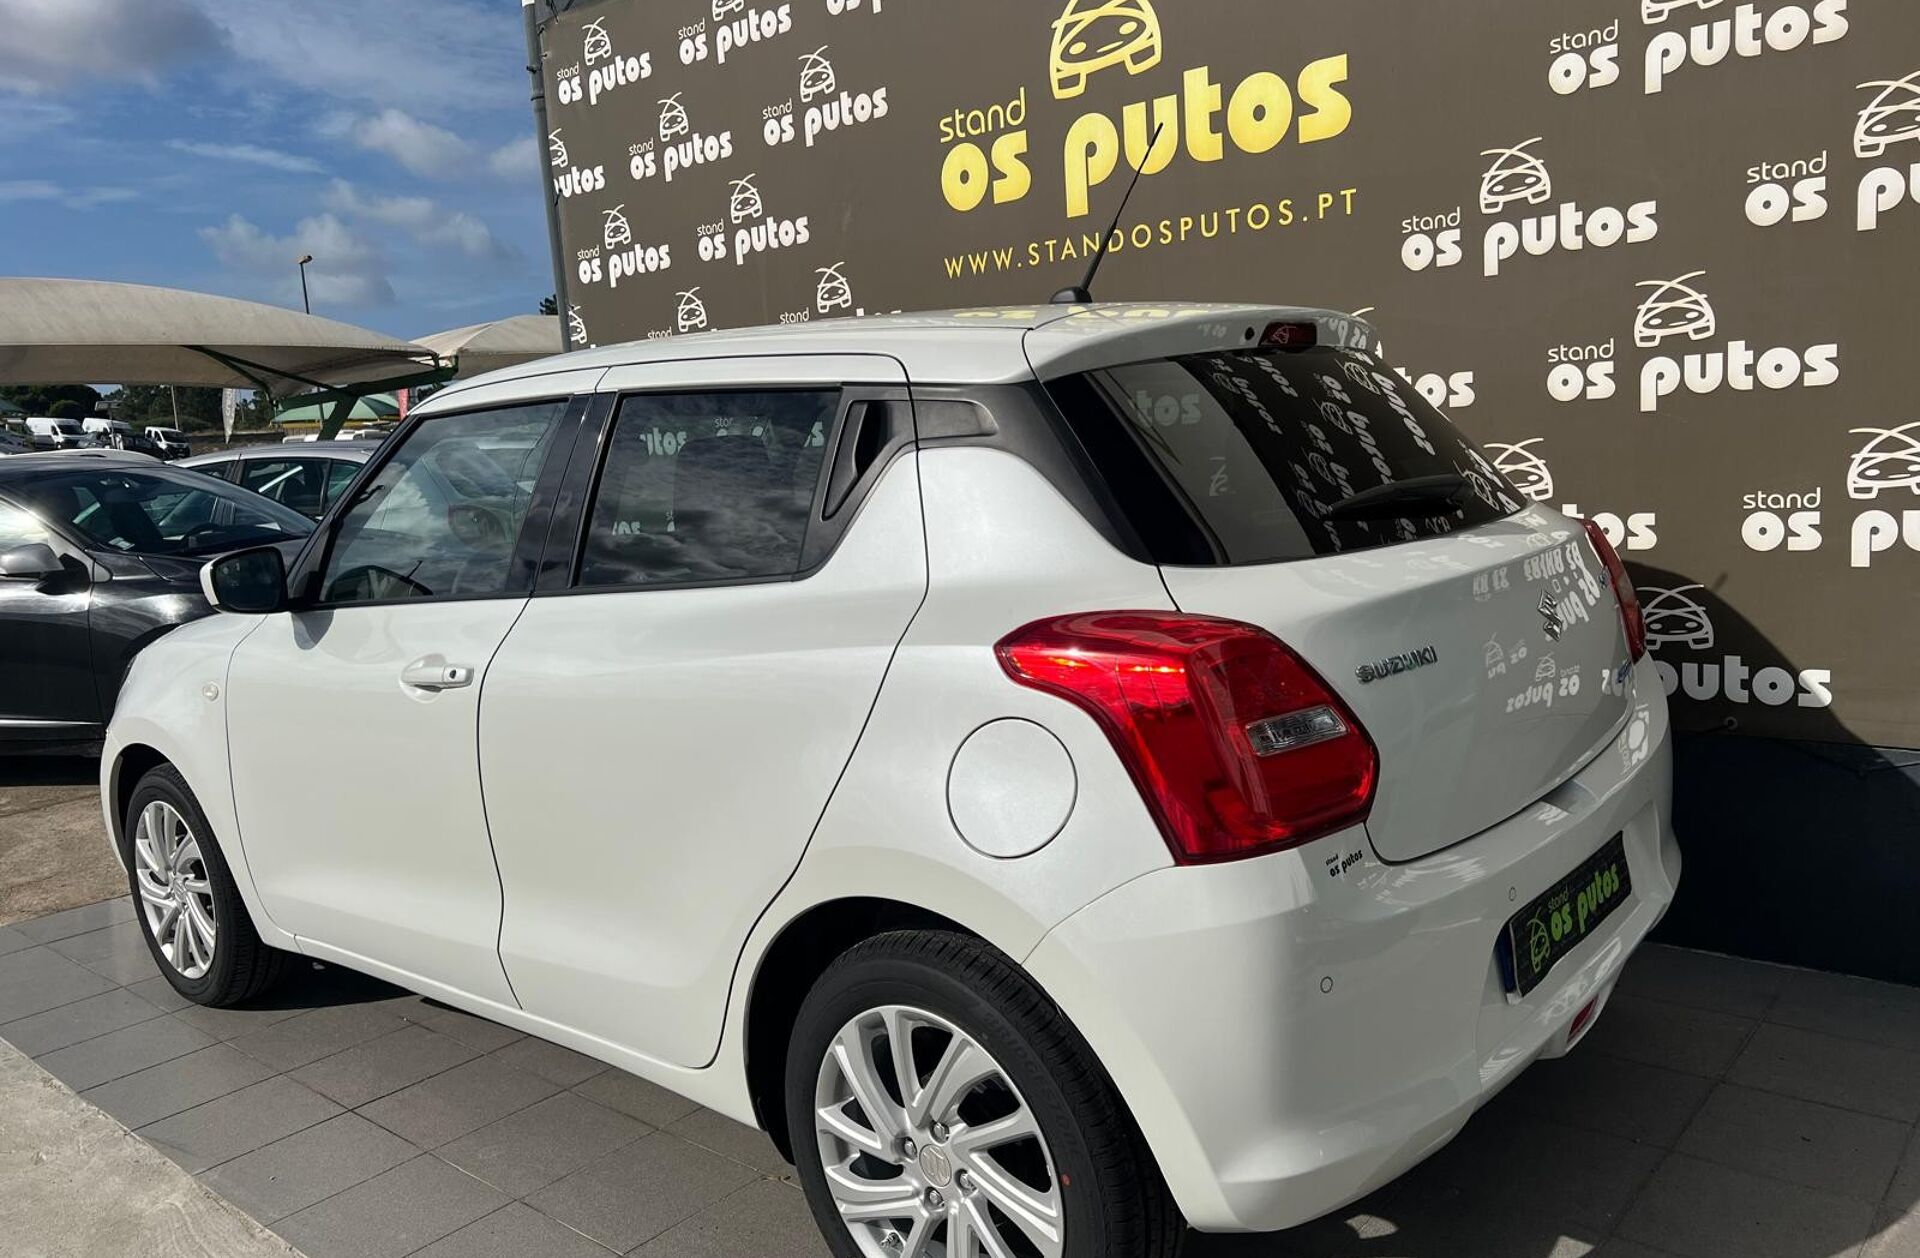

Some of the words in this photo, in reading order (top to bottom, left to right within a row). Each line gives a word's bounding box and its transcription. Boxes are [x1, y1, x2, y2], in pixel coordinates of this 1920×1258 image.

[678, 17, 705, 39] stand
[679, 32, 708, 65] os
[716, 4, 792, 64] putos
[1549, 44, 1620, 94] os
[1645, 0, 1849, 94] putos
[1550, 19, 1619, 54] stand
[557, 62, 580, 78] stand
[558, 78, 582, 105] os
[589, 51, 652, 105] putos
[762, 98, 793, 119] stand
[763, 113, 795, 146] os
[804, 87, 889, 147] putos
[940, 87, 1027, 143] stand
[629, 138, 654, 156] stand
[941, 130, 1031, 211] os
[1064, 54, 1352, 218] putos
[630, 151, 656, 180] os
[664, 131, 733, 182] putos
[1747, 151, 1828, 184] stand
[553, 166, 605, 198] utos
[1745, 175, 1828, 227] os
[697, 219, 724, 236] stand
[944, 188, 1358, 279] WWW.STANDOSPUTOS.PT
[1402, 207, 1461, 234] stand
[1402, 229, 1462, 271] os
[1484, 201, 1658, 276] putos
[577, 245, 600, 260] stand
[698, 232, 727, 262] os
[735, 216, 810, 265] putos
[578, 258, 602, 284] os
[609, 244, 671, 288] putos
[779, 307, 809, 325] stand
[1548, 338, 1614, 363] stand
[1547, 360, 1616, 401] os
[1640, 341, 1839, 412] putos
[1743, 487, 1821, 509] stand
[1741, 511, 1823, 551] os
[1354, 645, 1439, 684] SUZUKI
[1329, 864, 1340, 877] os
[1341, 850, 1363, 874] putos
[1551, 902, 1572, 942] os
[1577, 863, 1619, 934] putos
